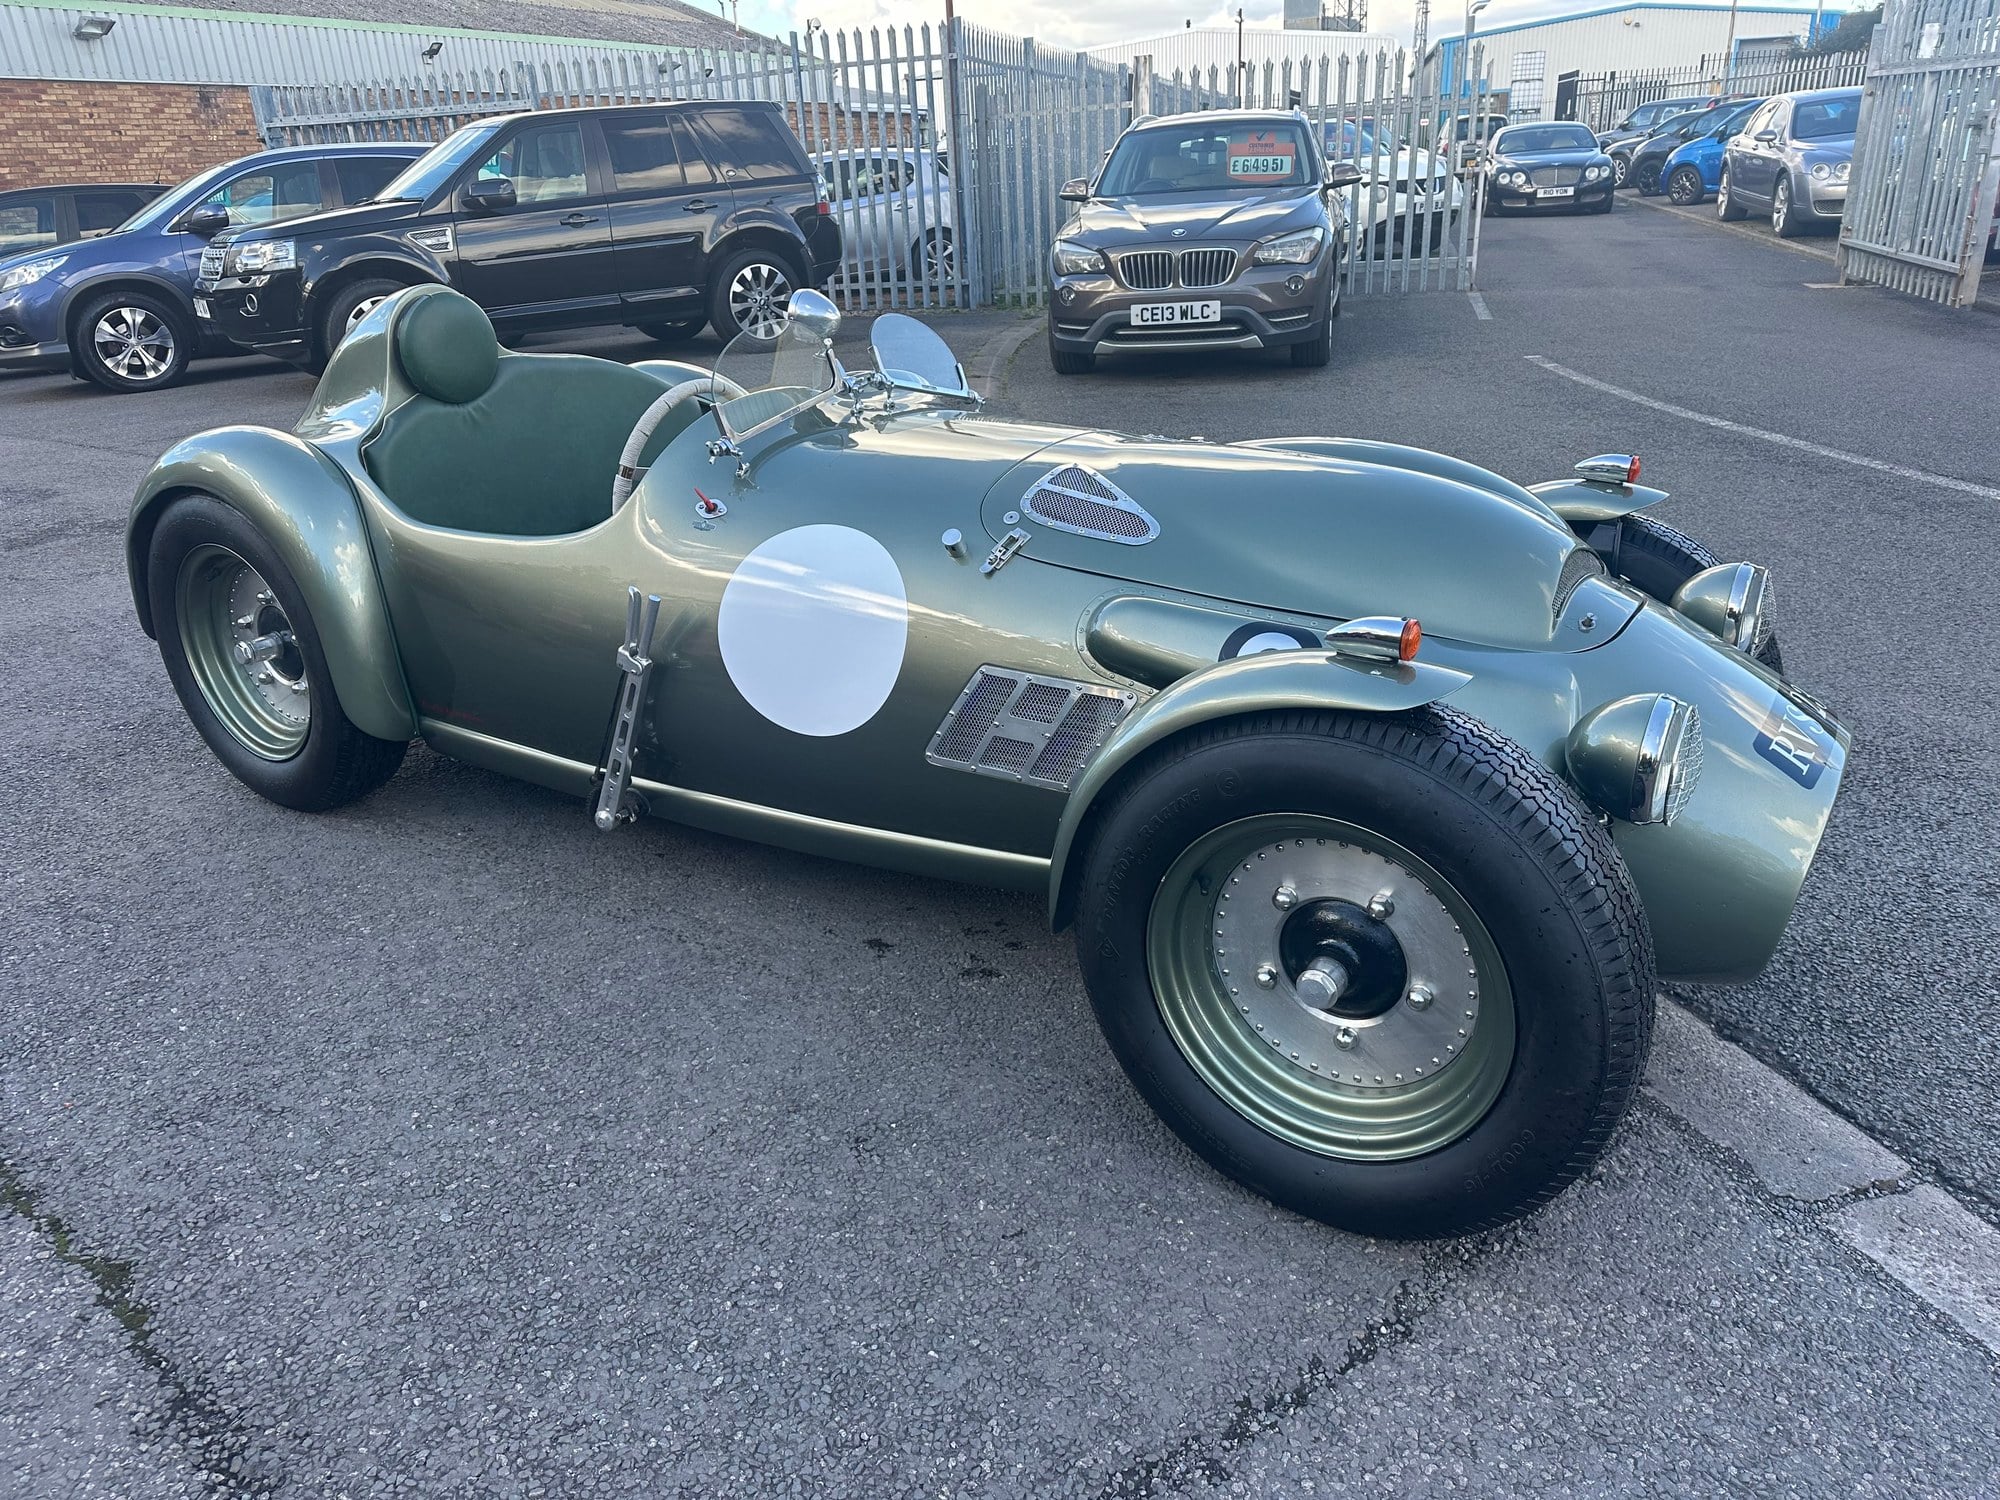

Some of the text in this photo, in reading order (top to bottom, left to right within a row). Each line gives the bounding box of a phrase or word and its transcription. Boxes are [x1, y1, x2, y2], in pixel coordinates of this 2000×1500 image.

[1140, 303, 1211, 323] CE13 WLC
[1769, 704, 1825, 776] RVS
